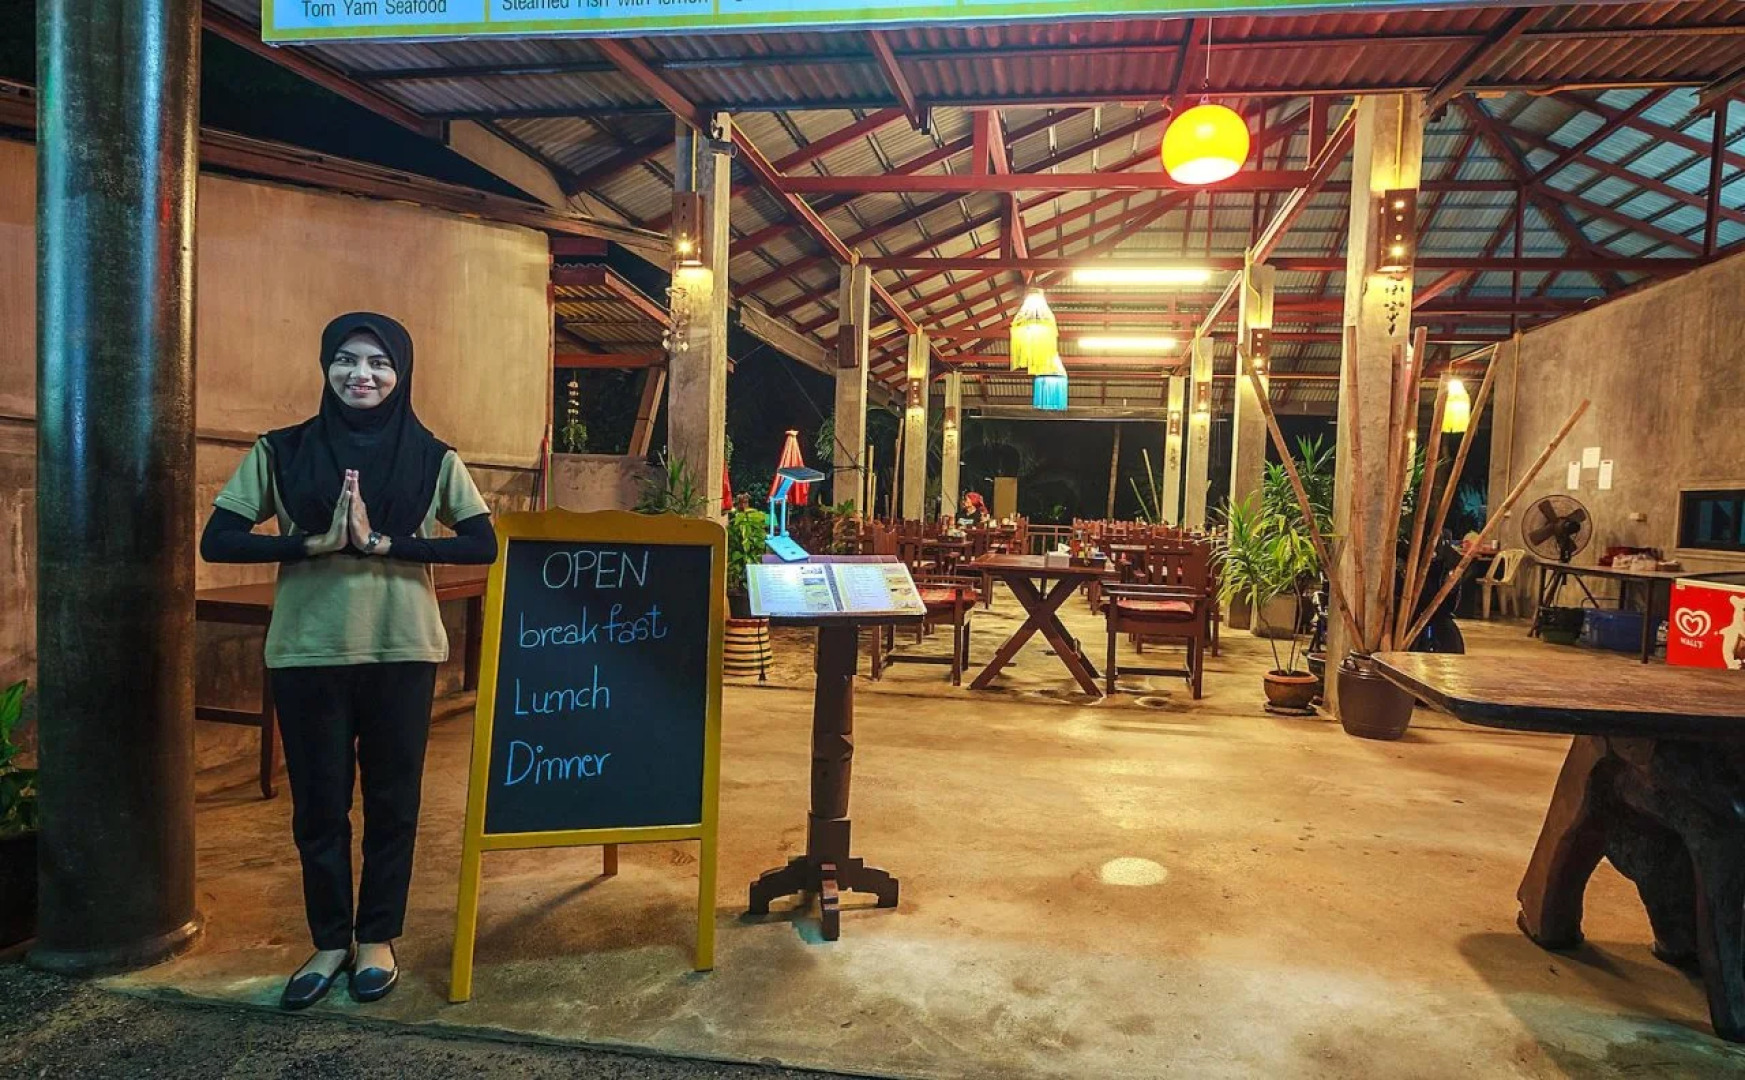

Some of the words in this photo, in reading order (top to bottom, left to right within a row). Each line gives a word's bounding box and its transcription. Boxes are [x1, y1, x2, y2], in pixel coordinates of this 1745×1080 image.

[302, 0, 335, 17] Tom
[344, 0, 377, 16] Yam
[385, 0, 447, 14] Seafood
[543, 550, 648, 589] OPEN
[514, 665, 611, 715] Lunch
[504, 740, 612, 786] Dinner
